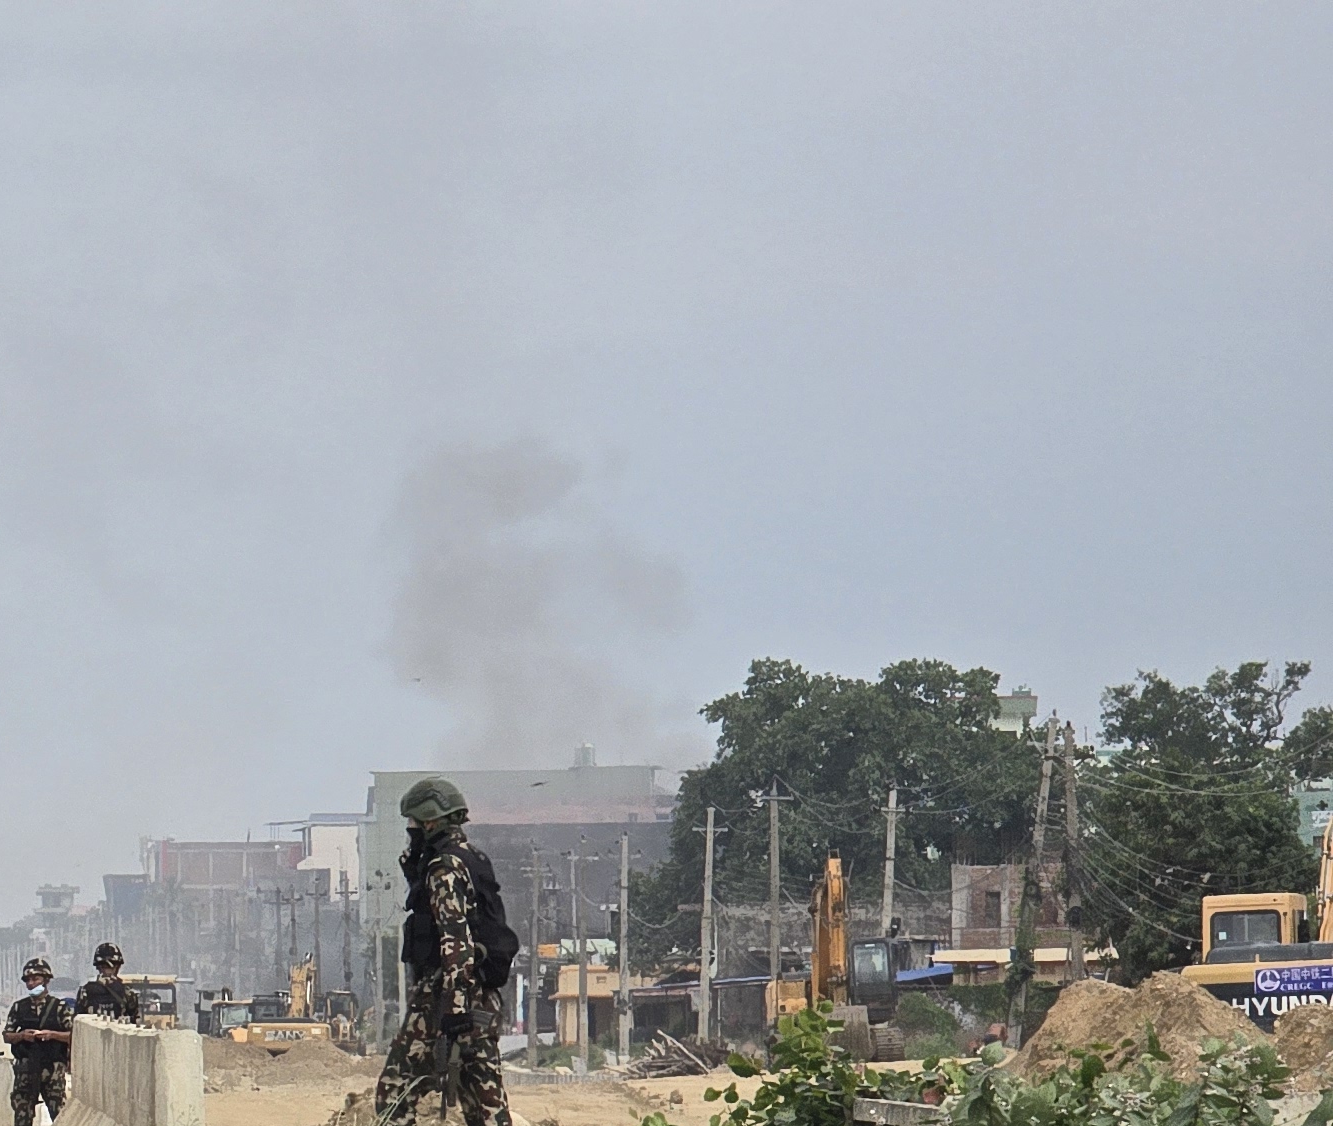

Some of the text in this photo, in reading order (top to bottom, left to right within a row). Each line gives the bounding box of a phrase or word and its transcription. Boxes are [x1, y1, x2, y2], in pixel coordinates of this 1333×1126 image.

[1281, 966, 1333, 981] 中国中铁二
[1232, 994, 1333, 1016] HYUND
[265, 1029, 306, 1041] SANY
